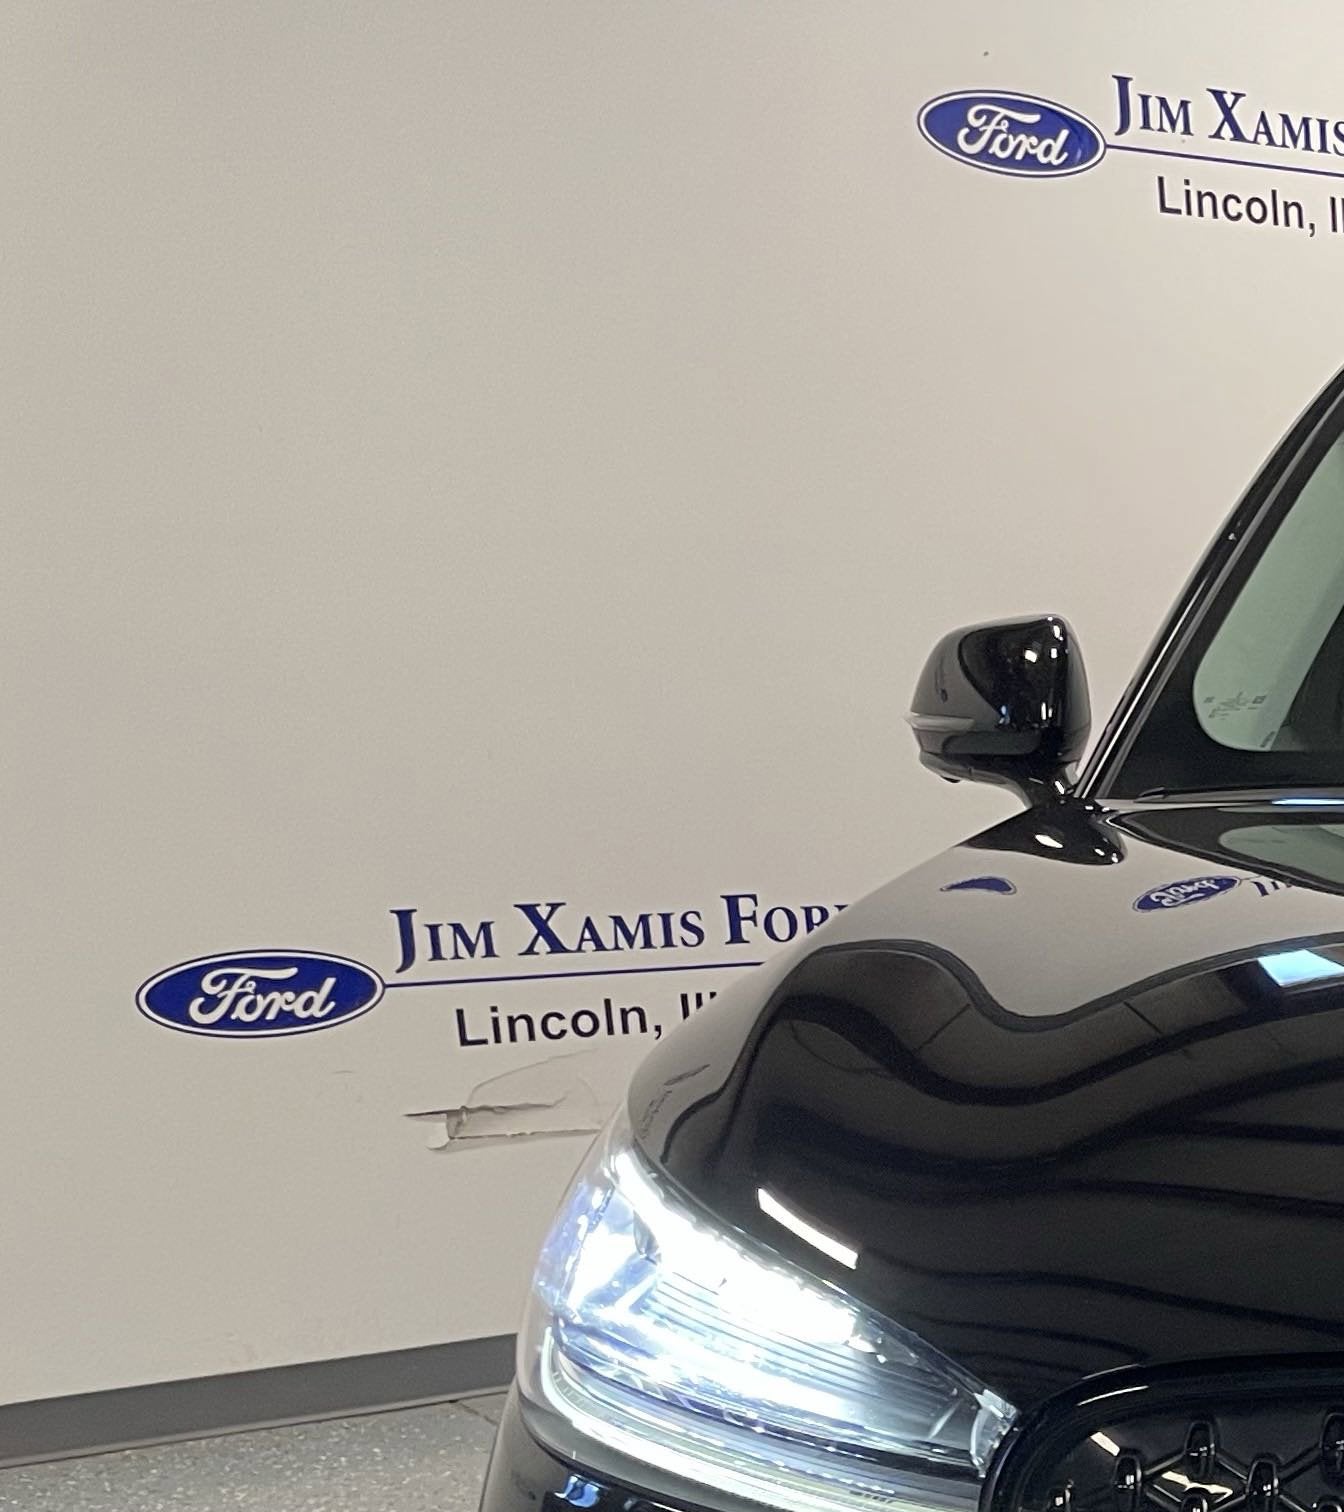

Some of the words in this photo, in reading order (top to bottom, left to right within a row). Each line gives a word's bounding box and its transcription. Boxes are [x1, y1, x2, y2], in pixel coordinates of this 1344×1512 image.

[957, 103, 1069, 167] Ford
[1111, 74, 1192, 136] JIM
[1157, 175, 1316, 237] Lincoln,
[390, 909, 499, 972] JIM
[514, 902, 705, 956] XAMIS
[189, 967, 335, 1023] Ford
[456, 998, 662, 1047] Lincoln,
